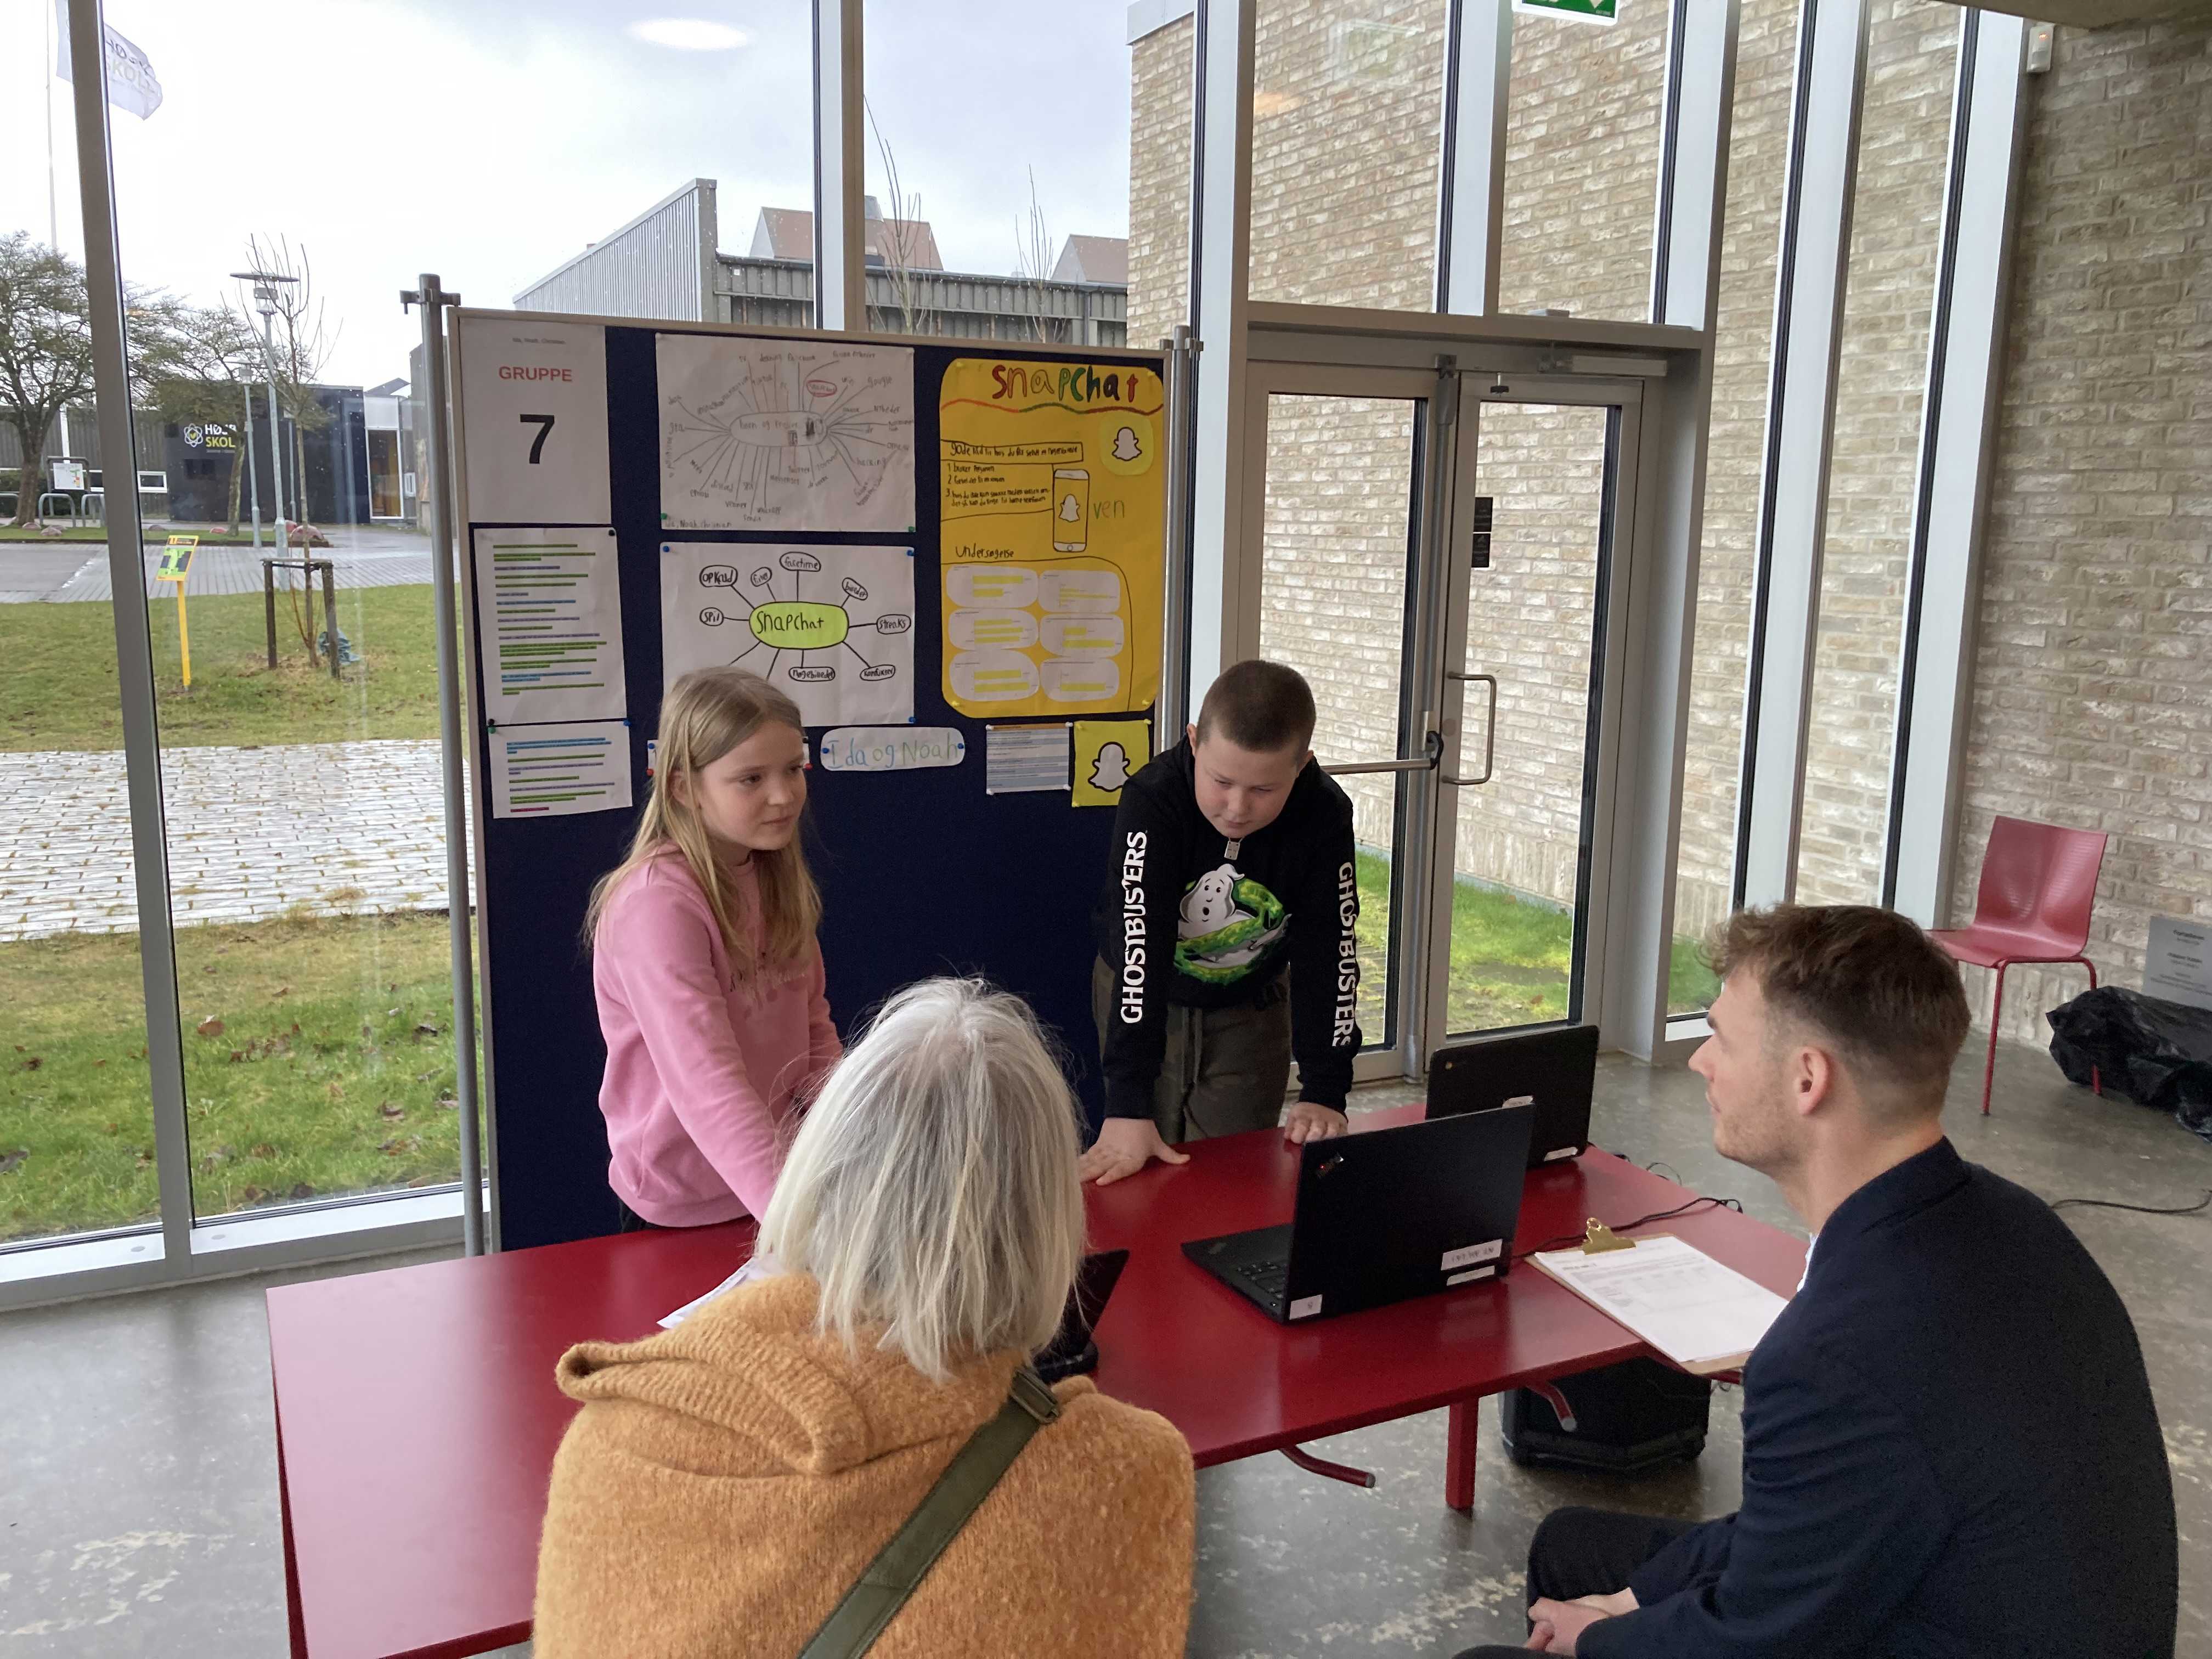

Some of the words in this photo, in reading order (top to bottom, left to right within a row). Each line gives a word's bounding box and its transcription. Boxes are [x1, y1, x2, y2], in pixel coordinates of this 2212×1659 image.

[499, 366, 572, 382] GRUPPE
[520, 414, 554, 464] 7
[947, 474, 951, 484] 2
[784, 556, 818, 569] facetime
[828, 738, 869, 769] Ida
[872, 744, 895, 769] og
[900, 732, 958, 765] Noah
[1120, 831, 1147, 1024] GHOSTBUSTERS
